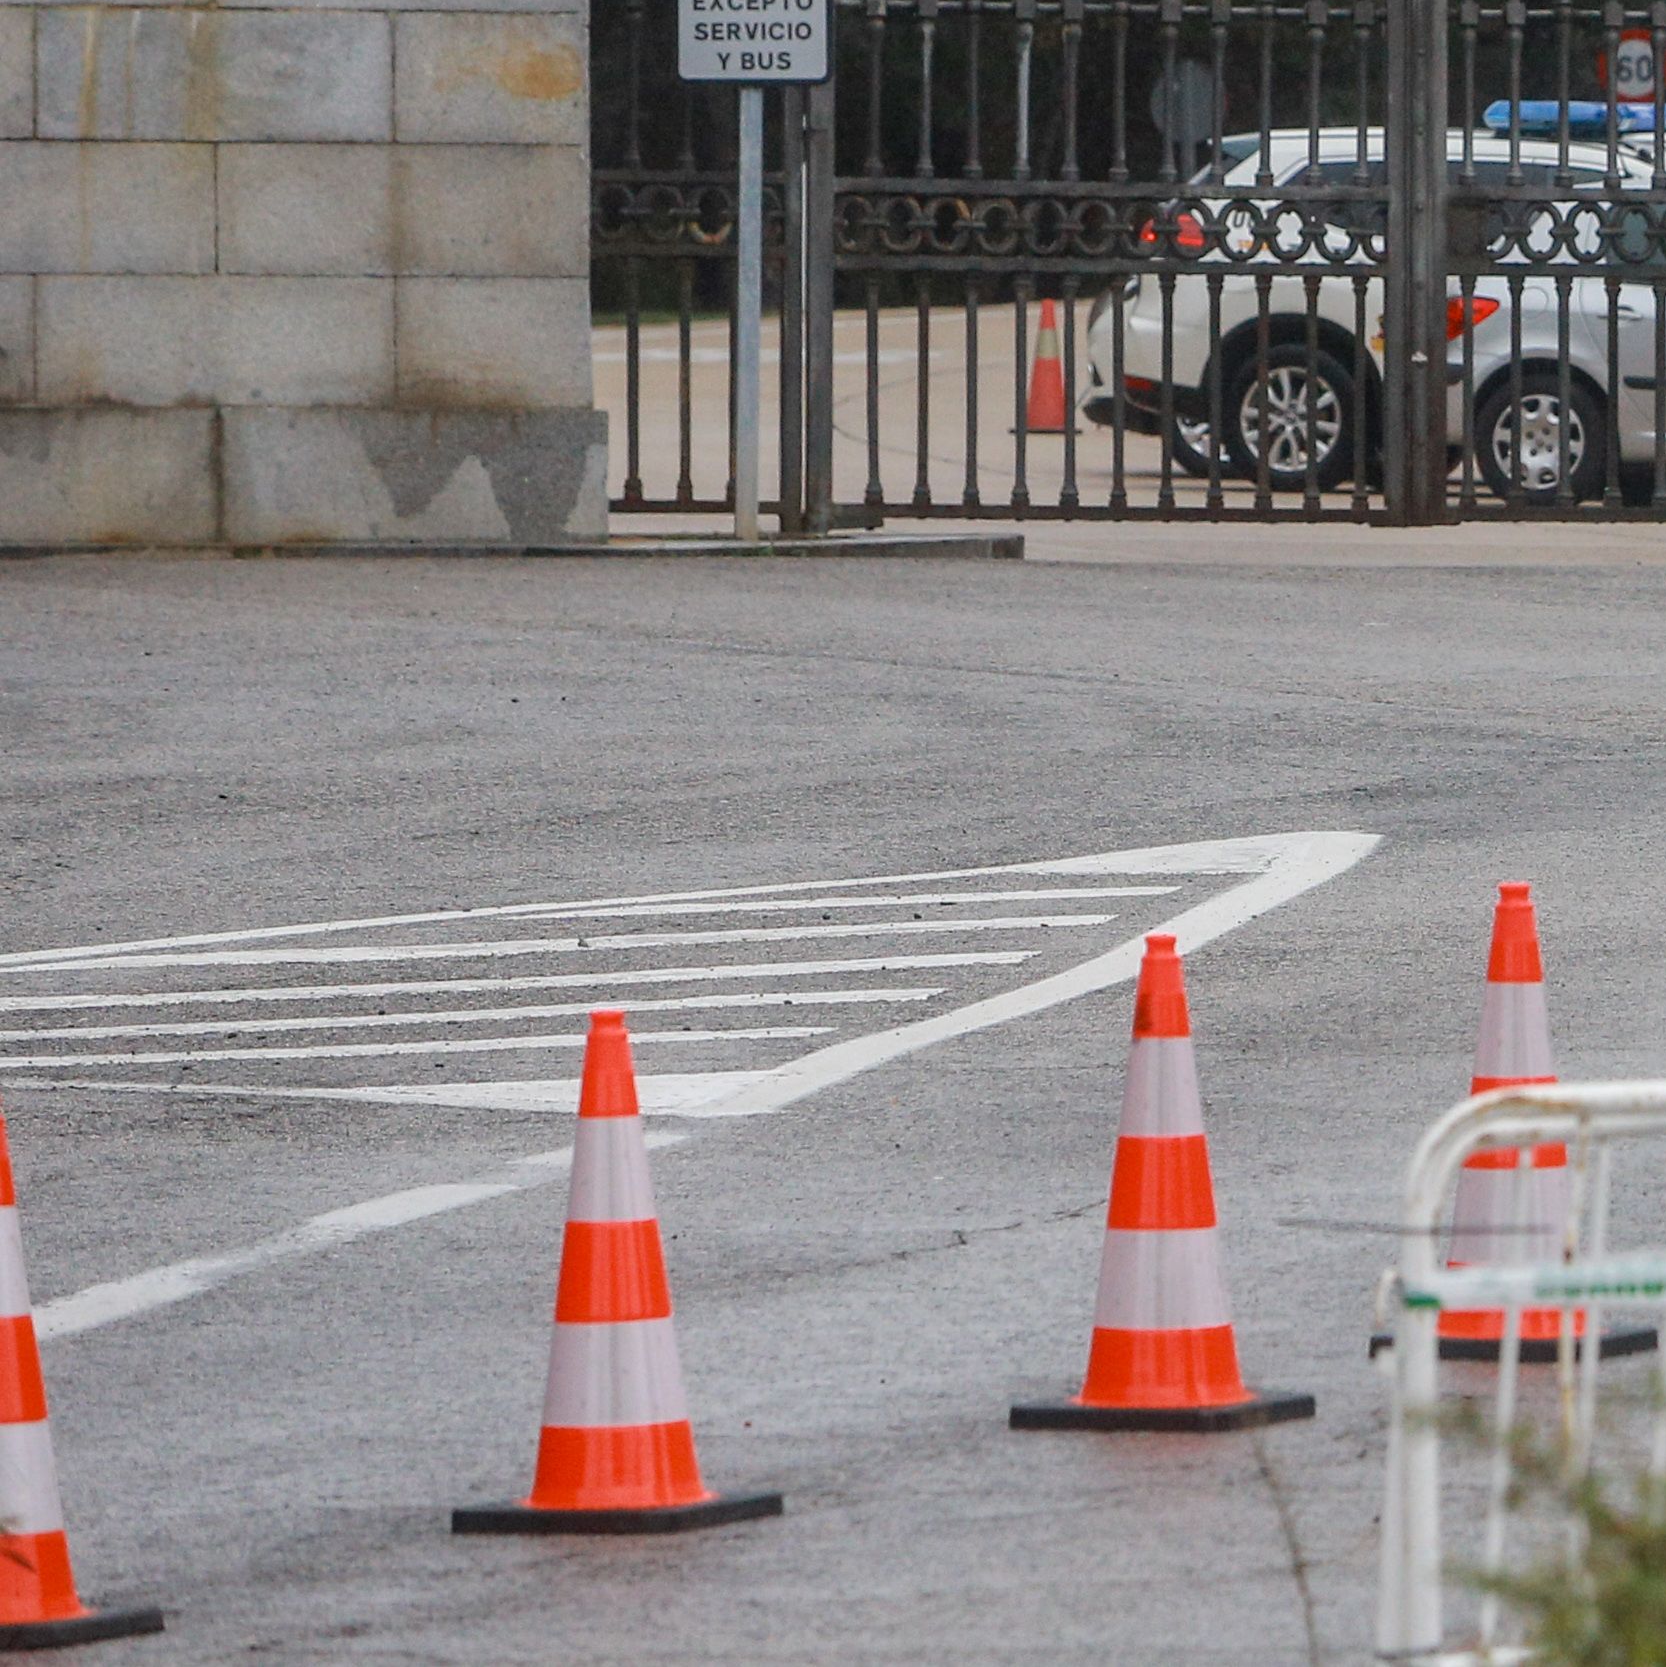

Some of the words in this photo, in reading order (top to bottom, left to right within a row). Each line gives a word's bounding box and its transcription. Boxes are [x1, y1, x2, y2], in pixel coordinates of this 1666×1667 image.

[694, 21, 812, 41] SERVICIO
[716, 51, 730, 70] Y
[741, 51, 791, 70] BUS
[1616, 54, 1653, 83] 60
